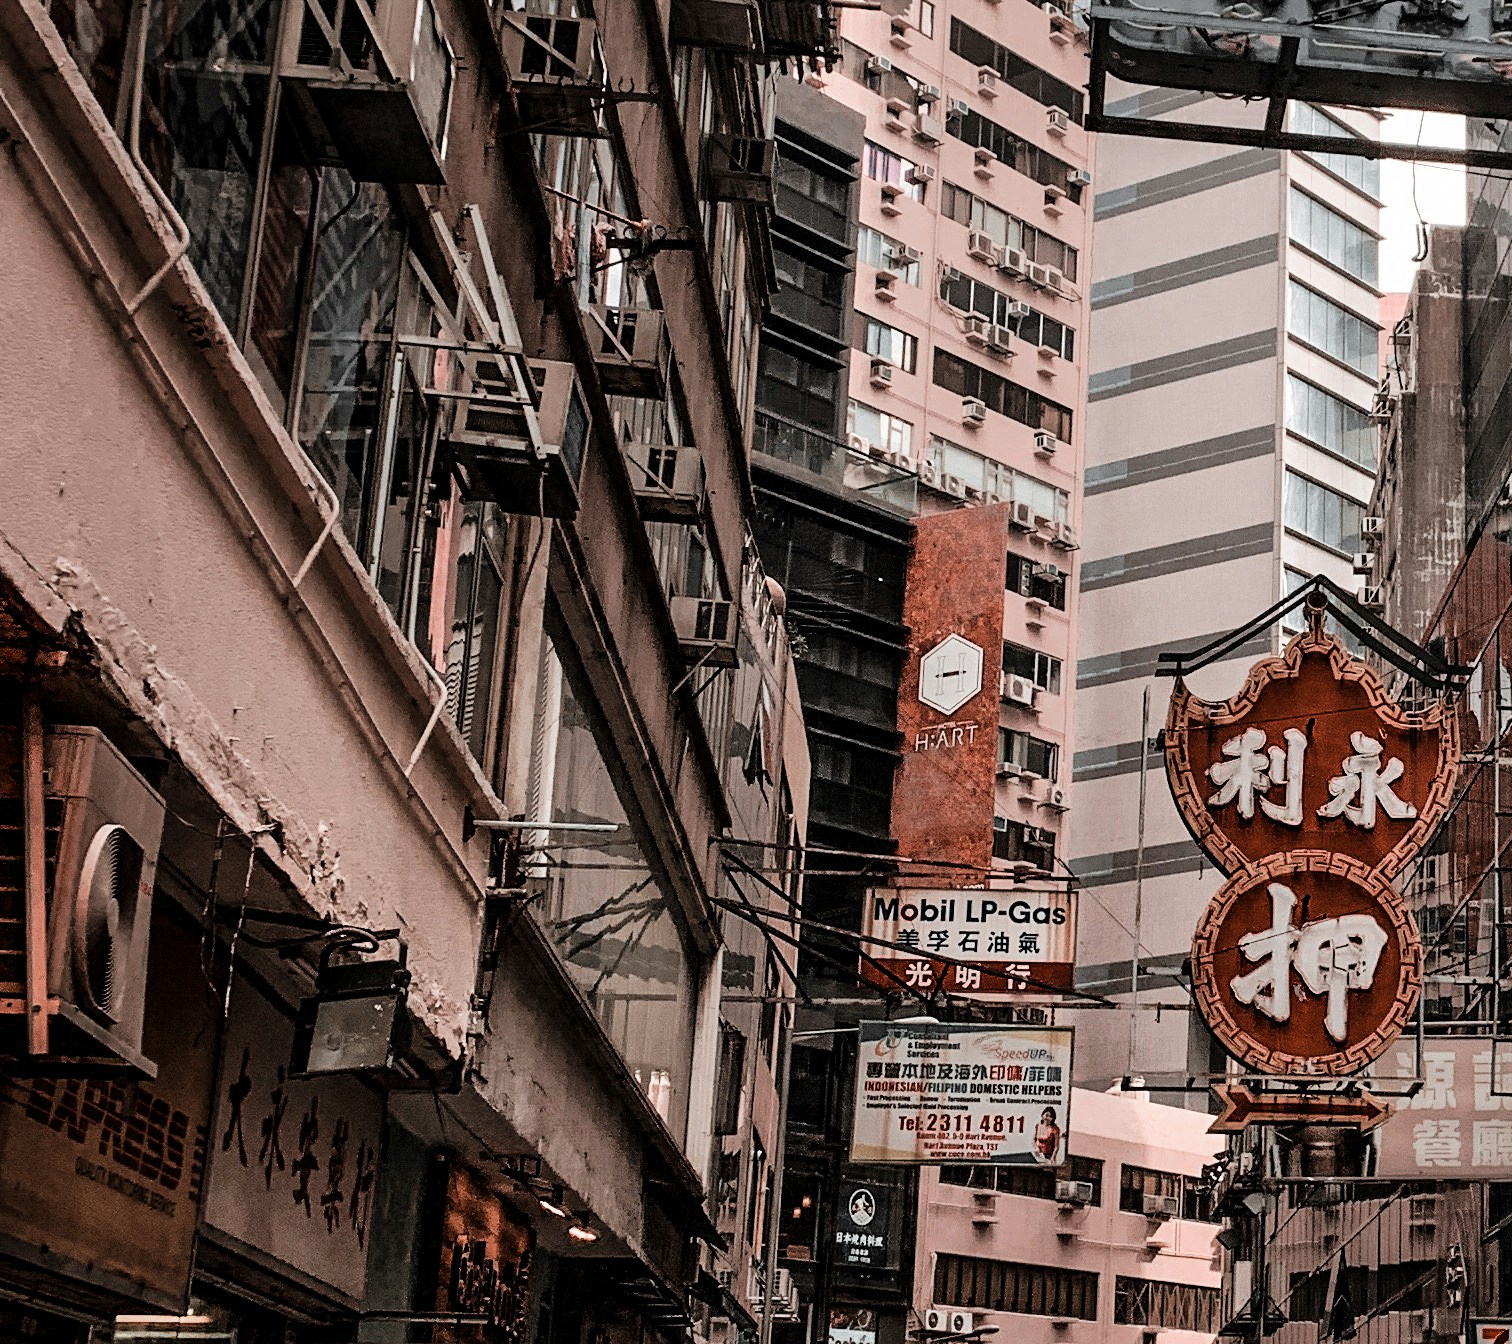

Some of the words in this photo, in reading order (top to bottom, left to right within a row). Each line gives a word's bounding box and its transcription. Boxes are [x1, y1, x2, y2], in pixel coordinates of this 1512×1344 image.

[875, 898, 954, 922] Mobil
[966, 900, 1066, 925] LP-Gas
[897, 929, 1040, 954] 美孚石油氣
[906, 961, 1031, 989] 光明行
[1231, 881, 1389, 1043] 押
[970, 1083, 1019, 1095] DOMESTIC
[1022, 1085, 1062, 1096] HELPERS
[899, 1115, 923, 1131] Tel:
[928, 1113, 972, 1132] 2311
[980, 1115, 1025, 1133] 4811
